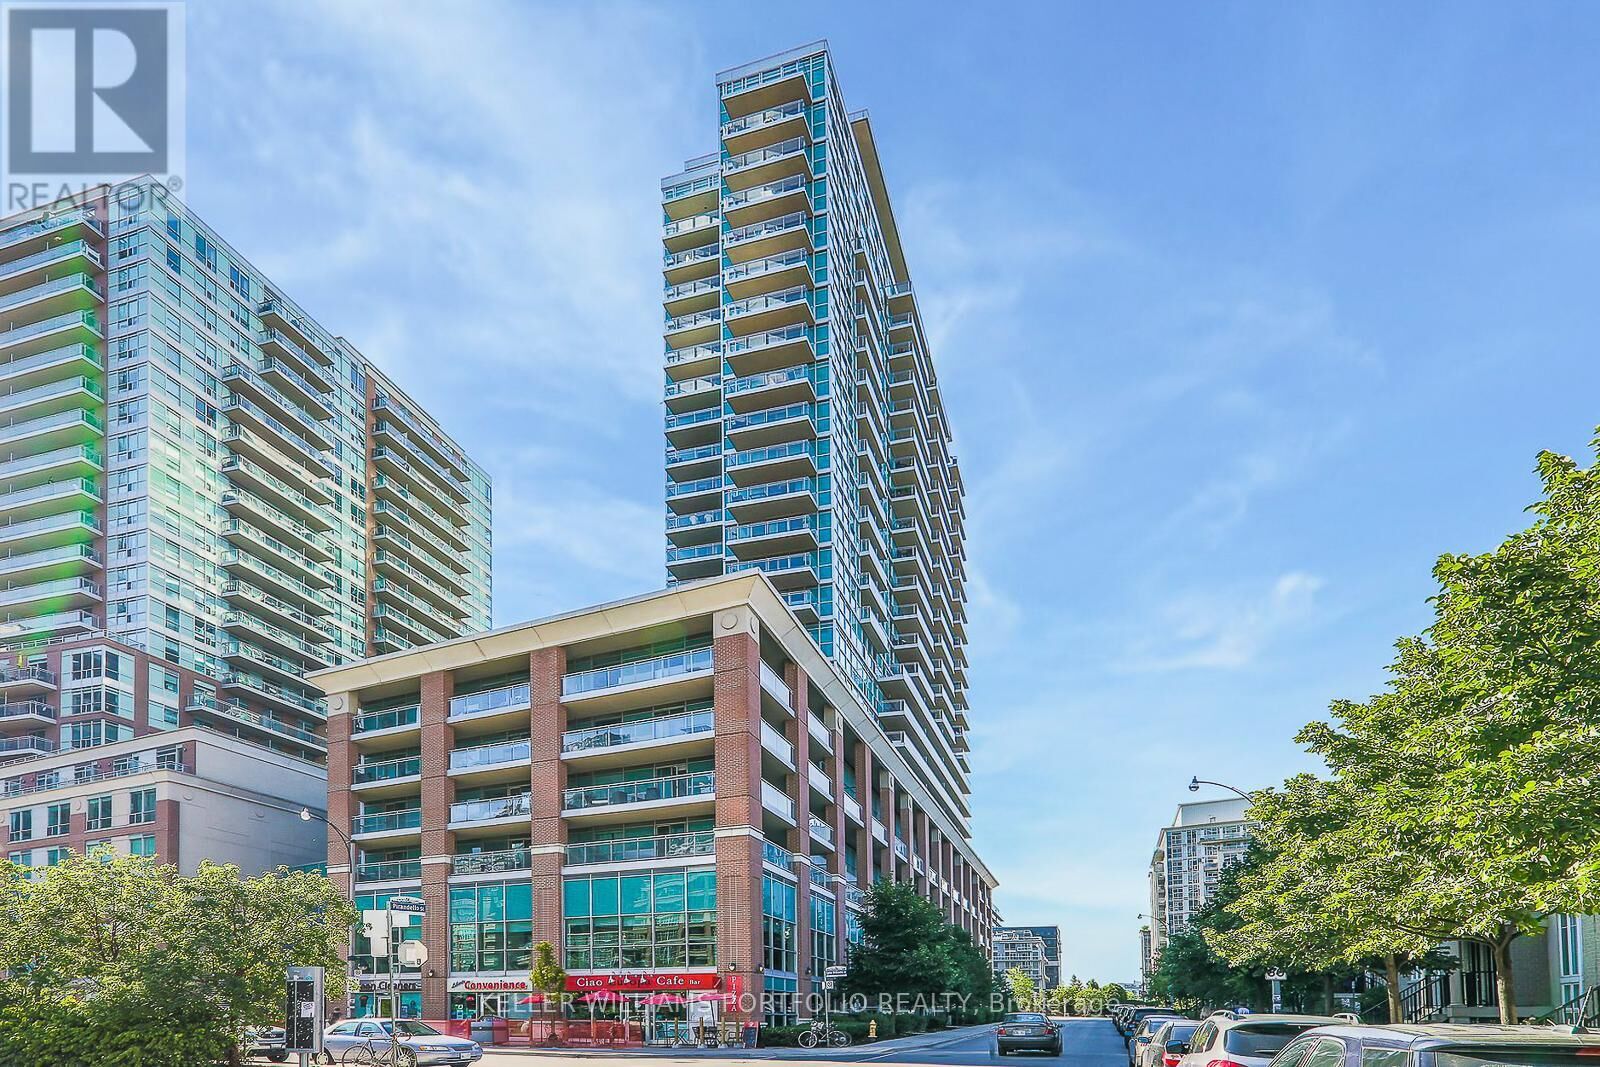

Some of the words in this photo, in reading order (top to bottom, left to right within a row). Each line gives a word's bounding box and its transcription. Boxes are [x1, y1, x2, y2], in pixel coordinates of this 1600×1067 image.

[464, 981, 526, 990] Convenience
[576, 977, 603, 987] Ciao
[656, 975, 685, 985] Cafe
